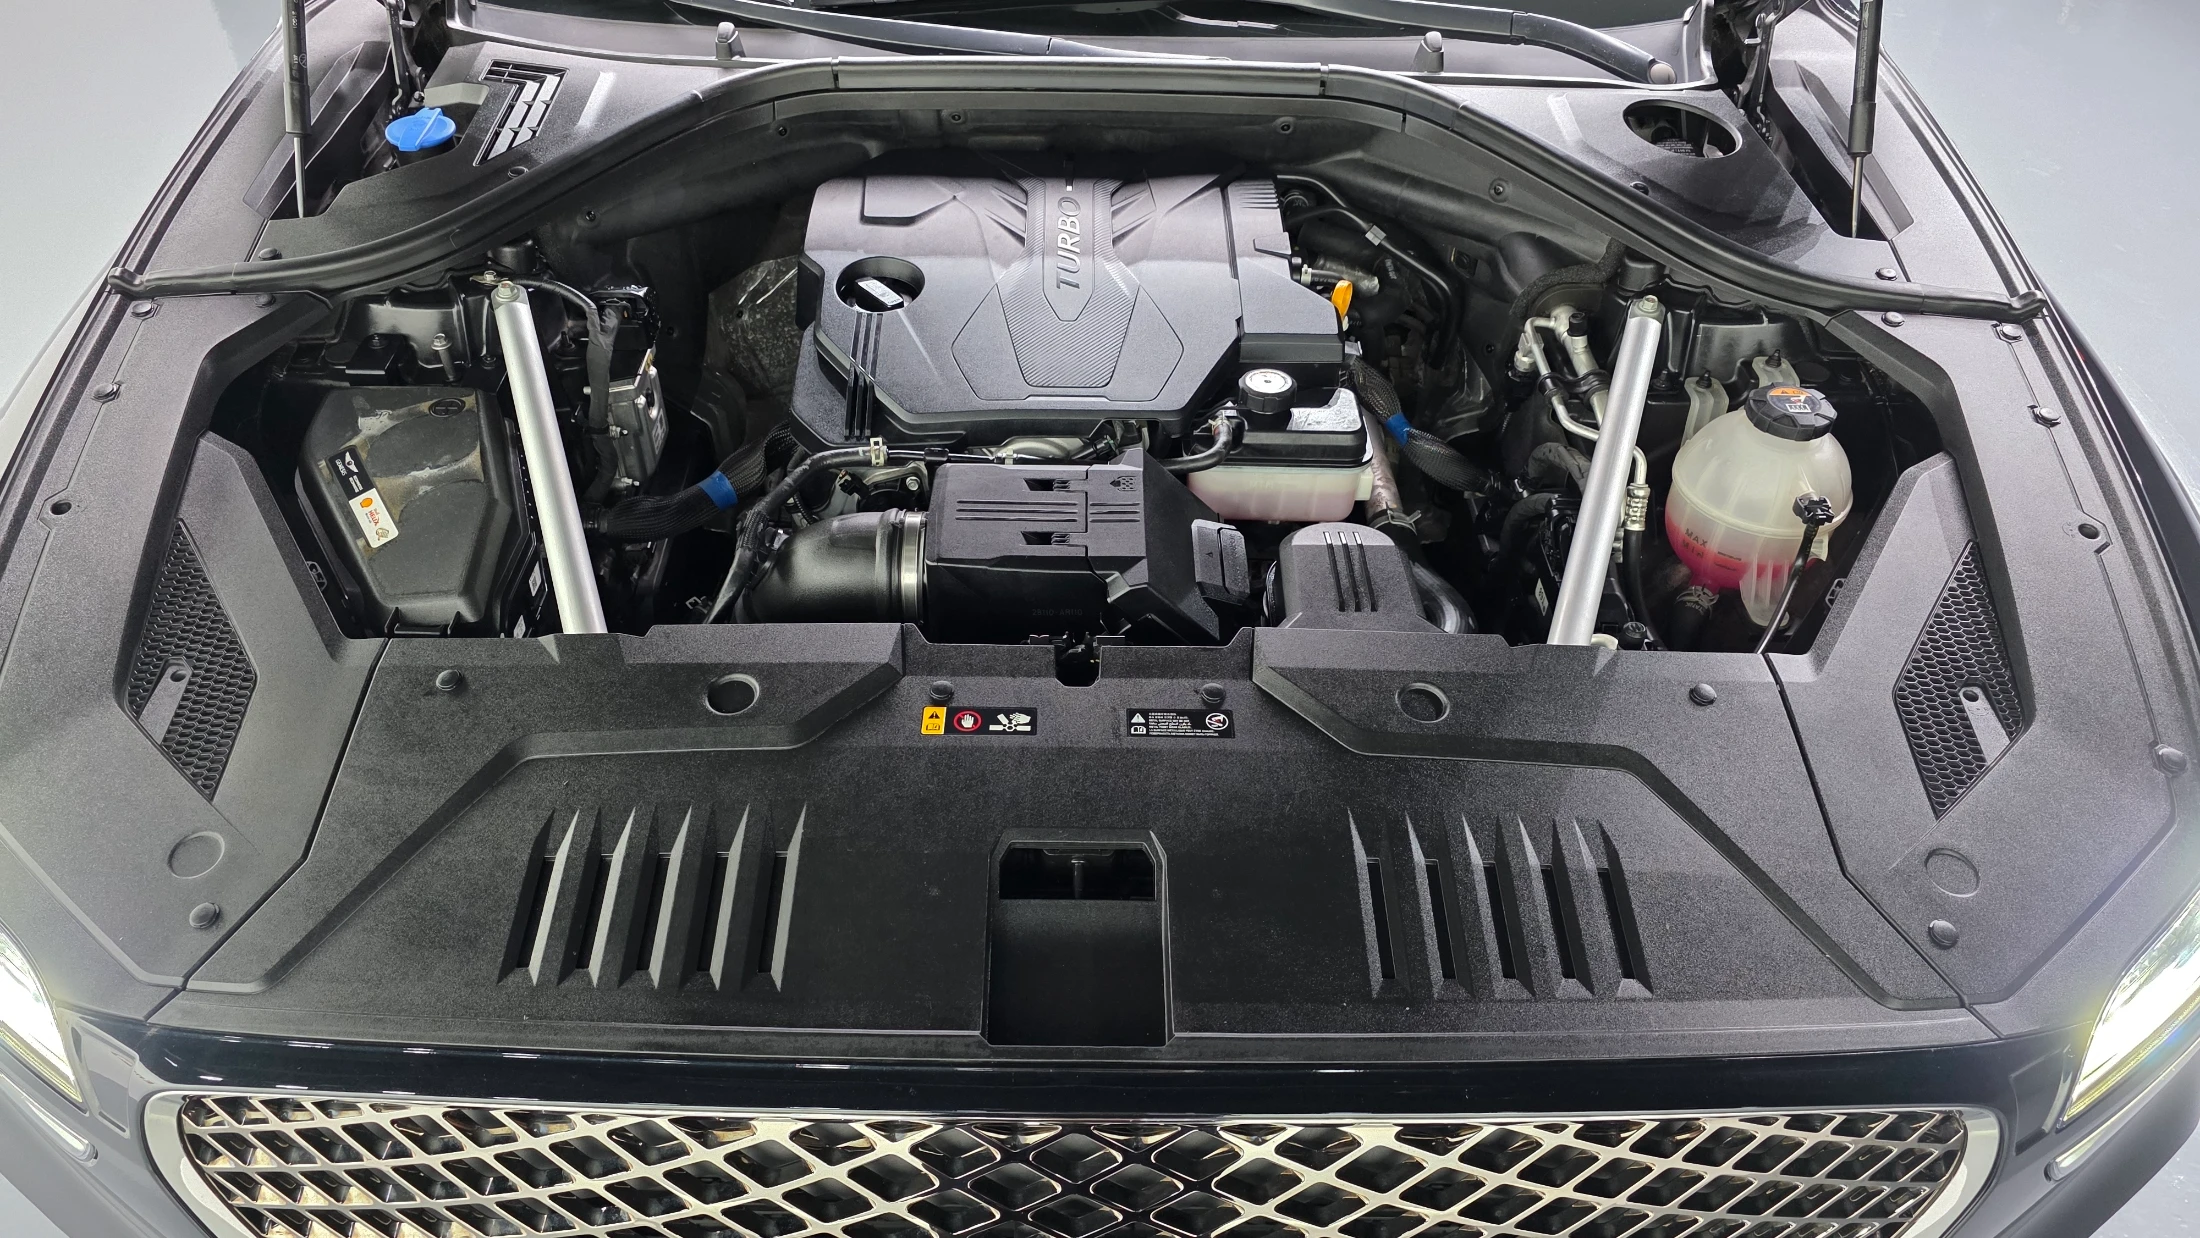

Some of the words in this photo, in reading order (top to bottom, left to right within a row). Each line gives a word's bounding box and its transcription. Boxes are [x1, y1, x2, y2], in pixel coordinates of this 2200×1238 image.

[1056, 196, 1081, 290] TURBO
[335, 458, 348, 476] GENESIS
[368, 509, 380, 526] HELIX
[1684, 527, 1708, 549] MAX
